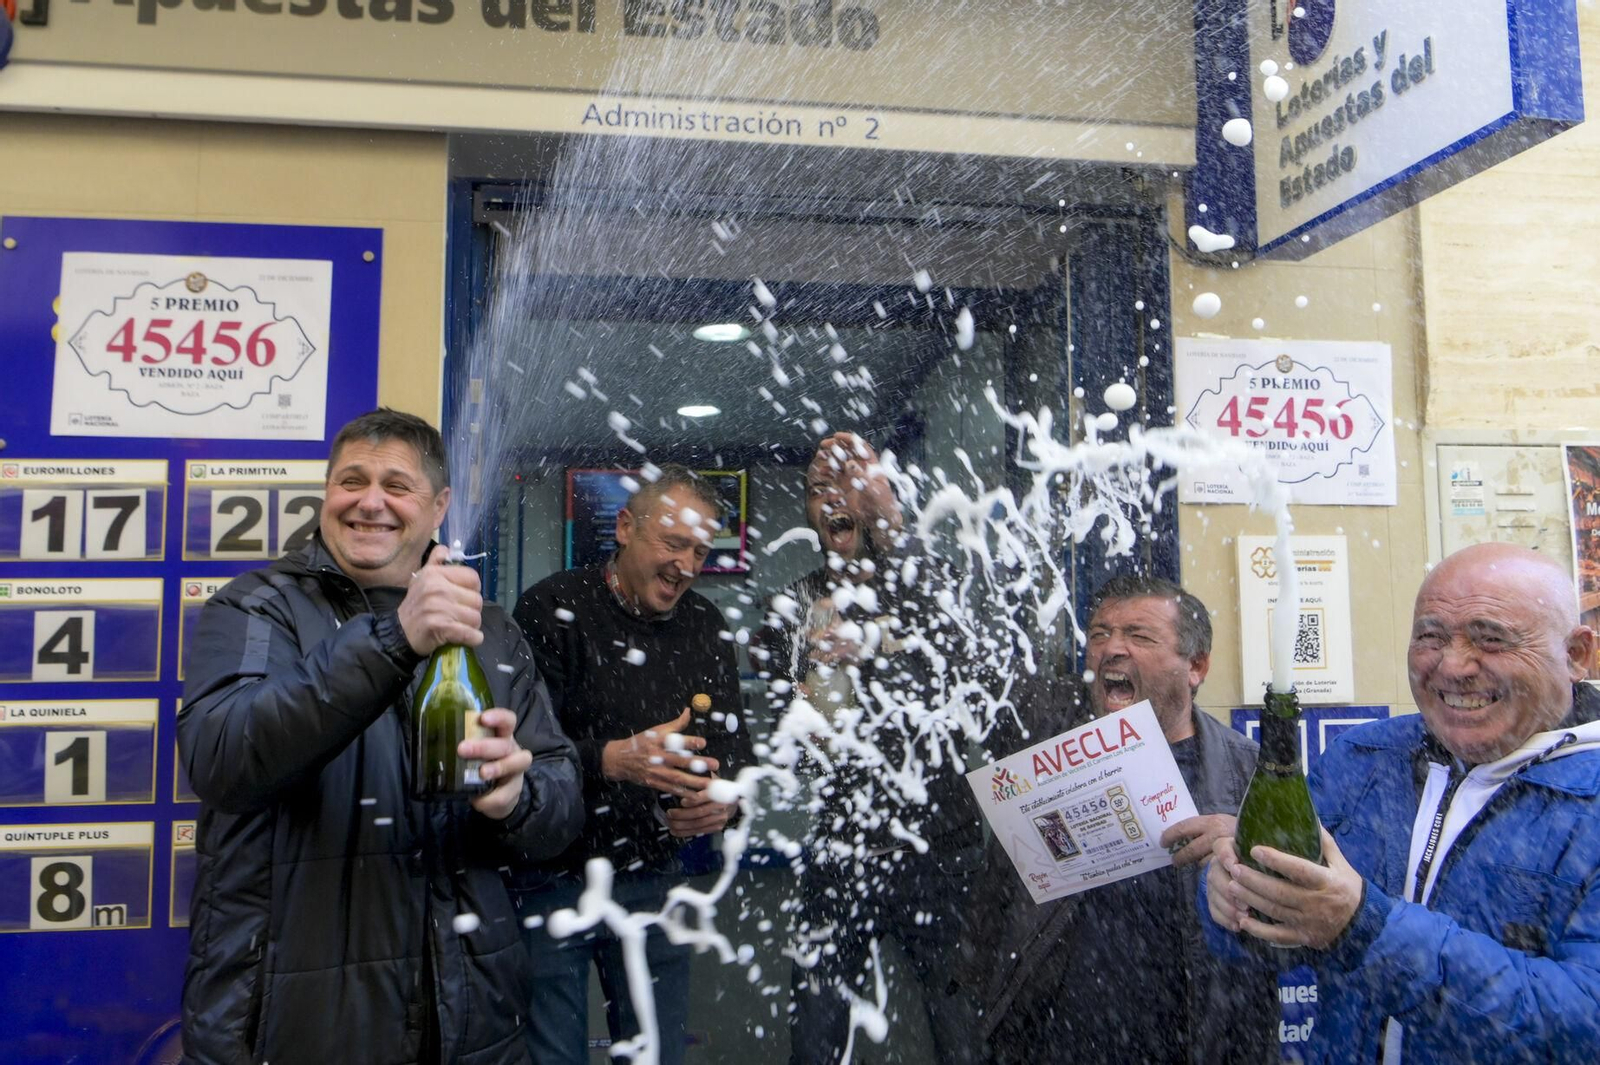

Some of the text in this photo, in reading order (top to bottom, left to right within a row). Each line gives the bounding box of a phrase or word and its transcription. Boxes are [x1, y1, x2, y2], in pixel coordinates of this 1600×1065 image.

[1372, 29, 1388, 71] y
[1279, 35, 1435, 169] Apuestas del
[581, 103, 881, 140] Administración nº 2
[1279, 144, 1357, 209] Estado
[150, 298, 240, 313] 5 PREMIO
[106, 317, 277, 368] 45456
[138, 367, 244, 381] VENDIDO AQUÍ
[1249, 377, 1321, 391] 5 PREMIO
[1216, 395, 1354, 440] 45456
[22, 466, 116, 477] EUROMILLONES
[210, 467, 288, 476] LA PRIMITIVA
[30, 494, 141, 553] 17
[16, 585, 83, 596] BONOLOTO
[36, 616, 90, 676] 4
[10, 707, 87, 718] LA QUINIELA
[1032, 717, 1143, 777] AVECLA
[54, 736, 91, 796] 1
[1065, 797, 1108, 820] 45456
[1156, 794, 1177, 823] ya!
[4, 829, 110, 842] QUÍNTUPLE PLUS
[36, 861, 86, 923] 8
[1278, 984, 1319, 1004] ues
